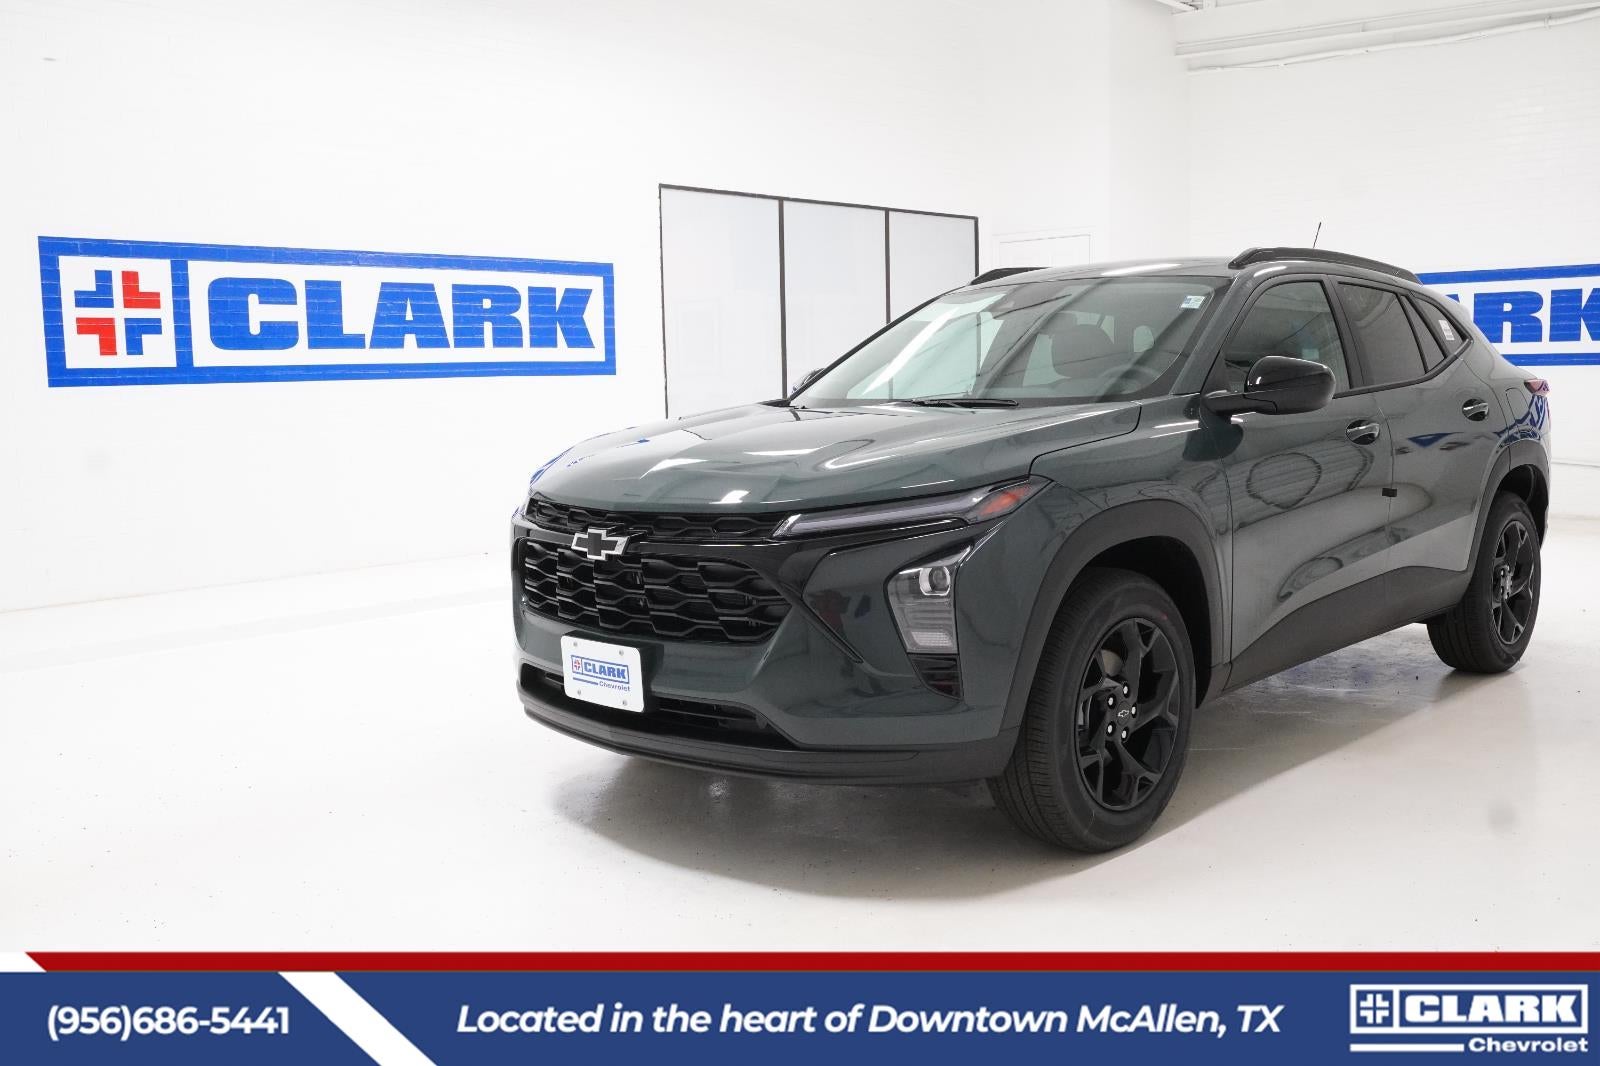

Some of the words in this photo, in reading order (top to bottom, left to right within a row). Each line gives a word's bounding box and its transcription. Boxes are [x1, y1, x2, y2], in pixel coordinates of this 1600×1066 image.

[208, 277, 596, 350] CLARK
[584, 662, 626, 679] CLARK
[600, 681, 630, 691] Chevrolet
